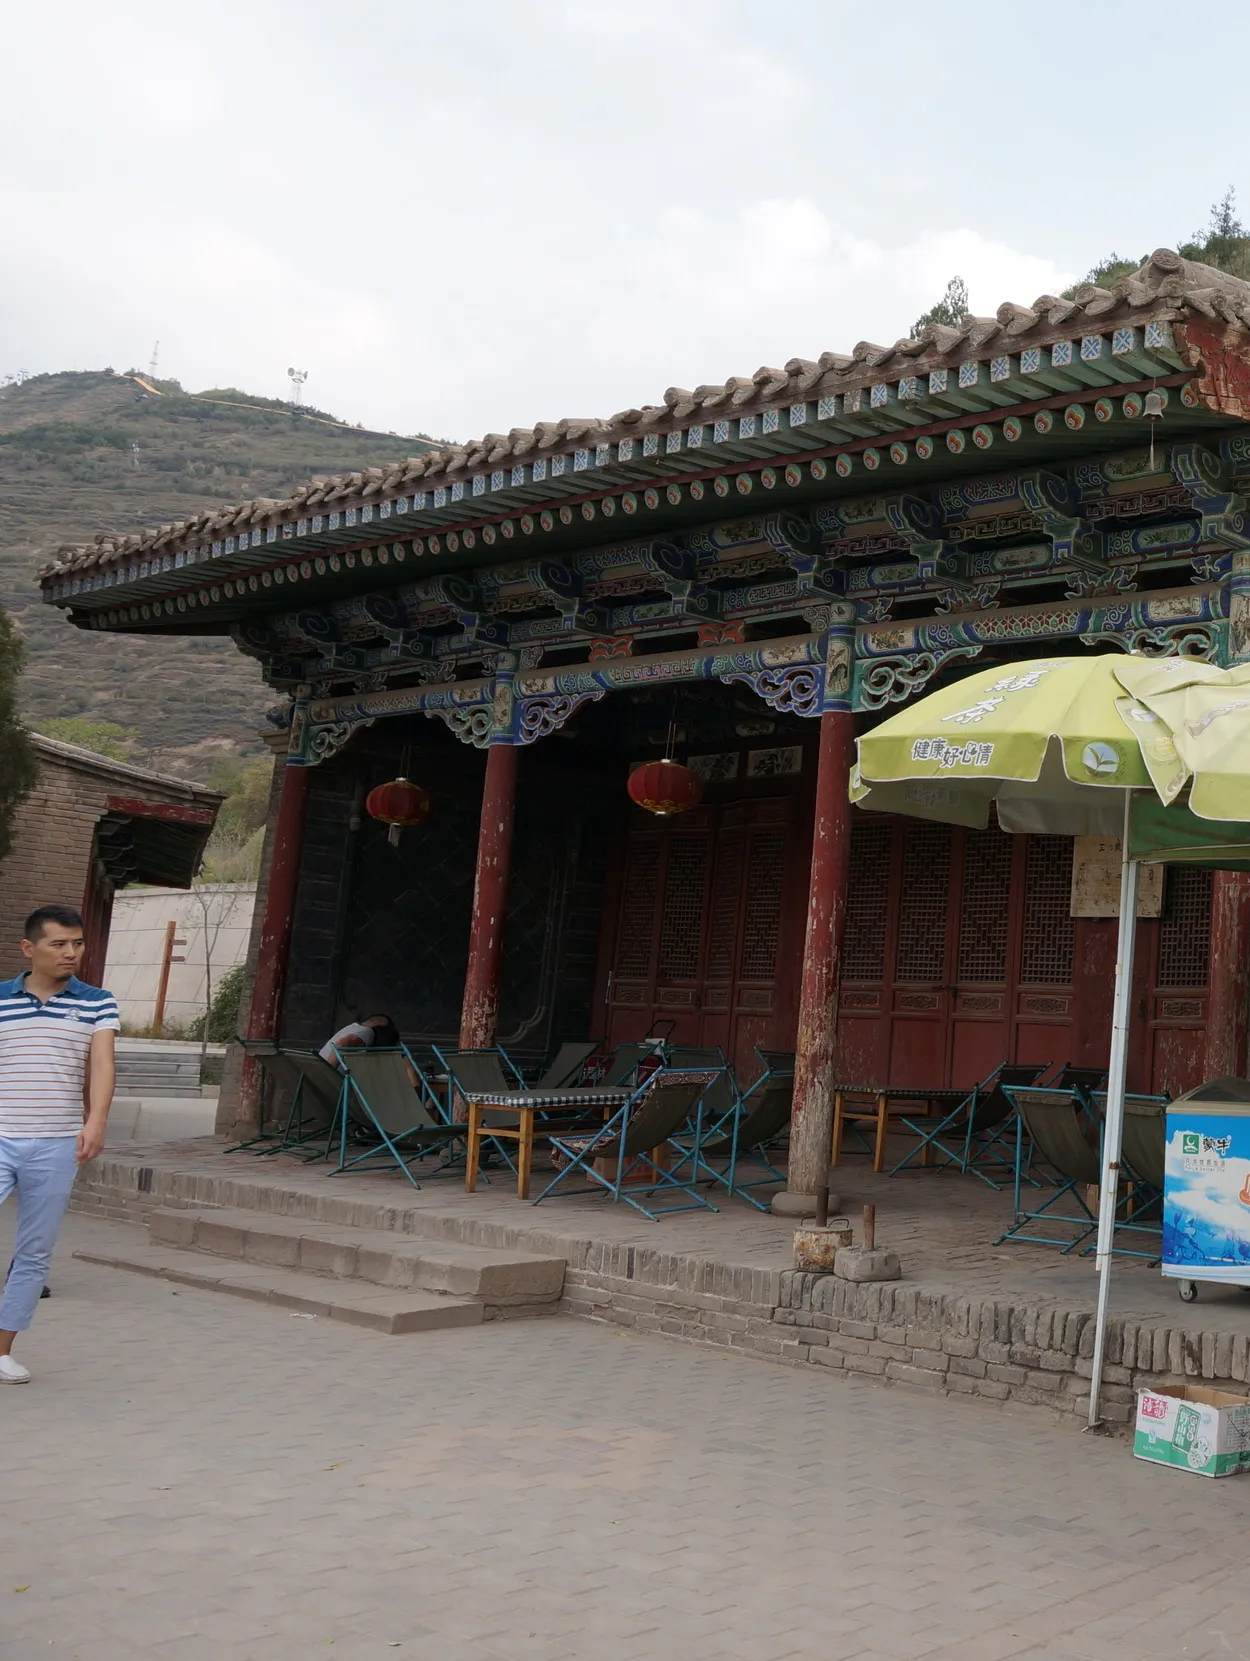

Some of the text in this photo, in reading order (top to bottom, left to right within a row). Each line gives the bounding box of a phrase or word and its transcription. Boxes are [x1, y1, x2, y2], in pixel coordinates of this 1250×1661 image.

[911, 738, 994, 769] 健康好心情
[1202, 1137, 1229, 1155] 蒙牛
